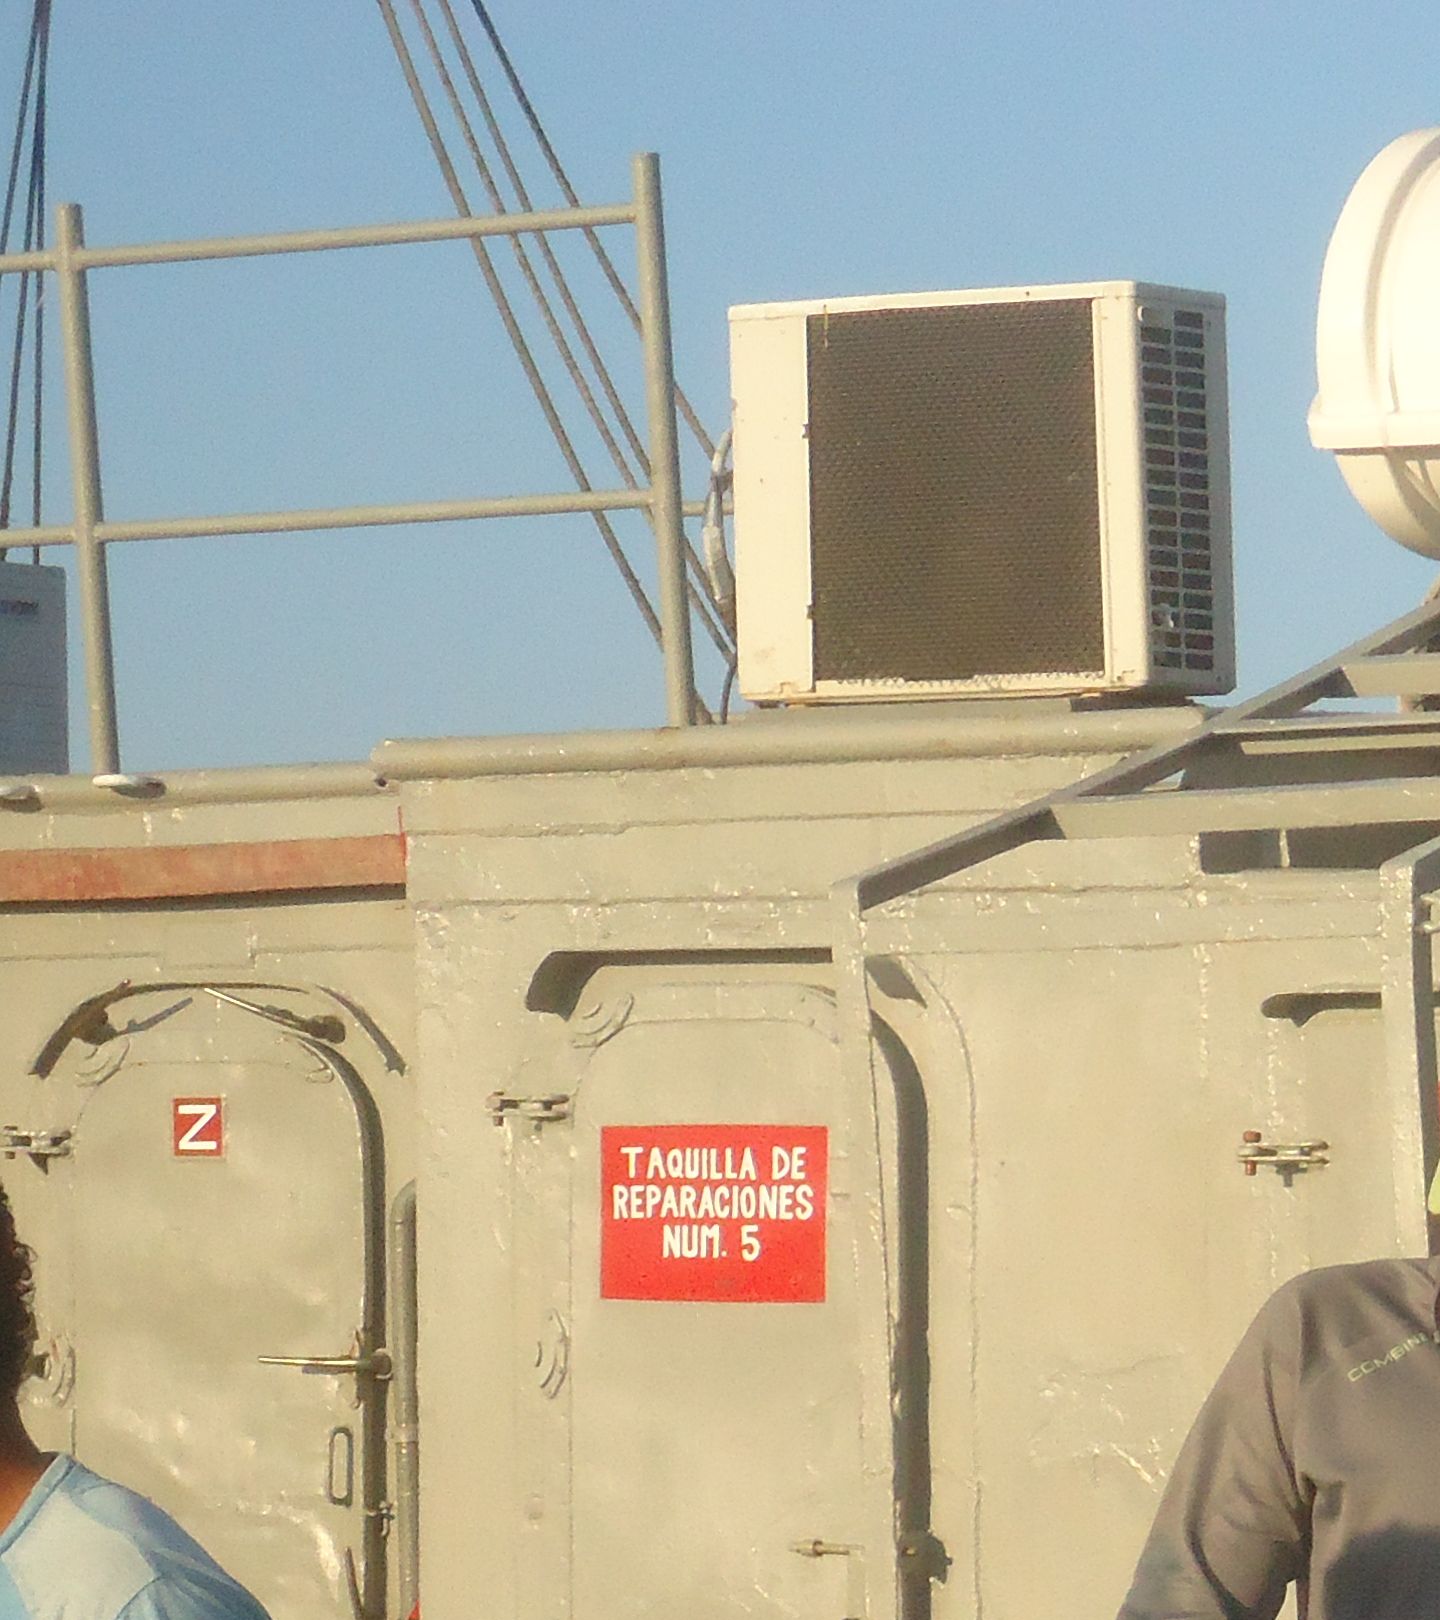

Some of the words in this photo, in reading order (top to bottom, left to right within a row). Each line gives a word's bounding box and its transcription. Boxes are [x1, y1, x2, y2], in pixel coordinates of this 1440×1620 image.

[178, 1104, 217, 1150] Z
[620, 1146, 757, 1181] TAQUILLA
[771, 1145, 807, 1180] DE
[612, 1184, 814, 1221] REPARACIONES
[662, 1223, 728, 1259] NUM.
[740, 1224, 761, 1262] 5
